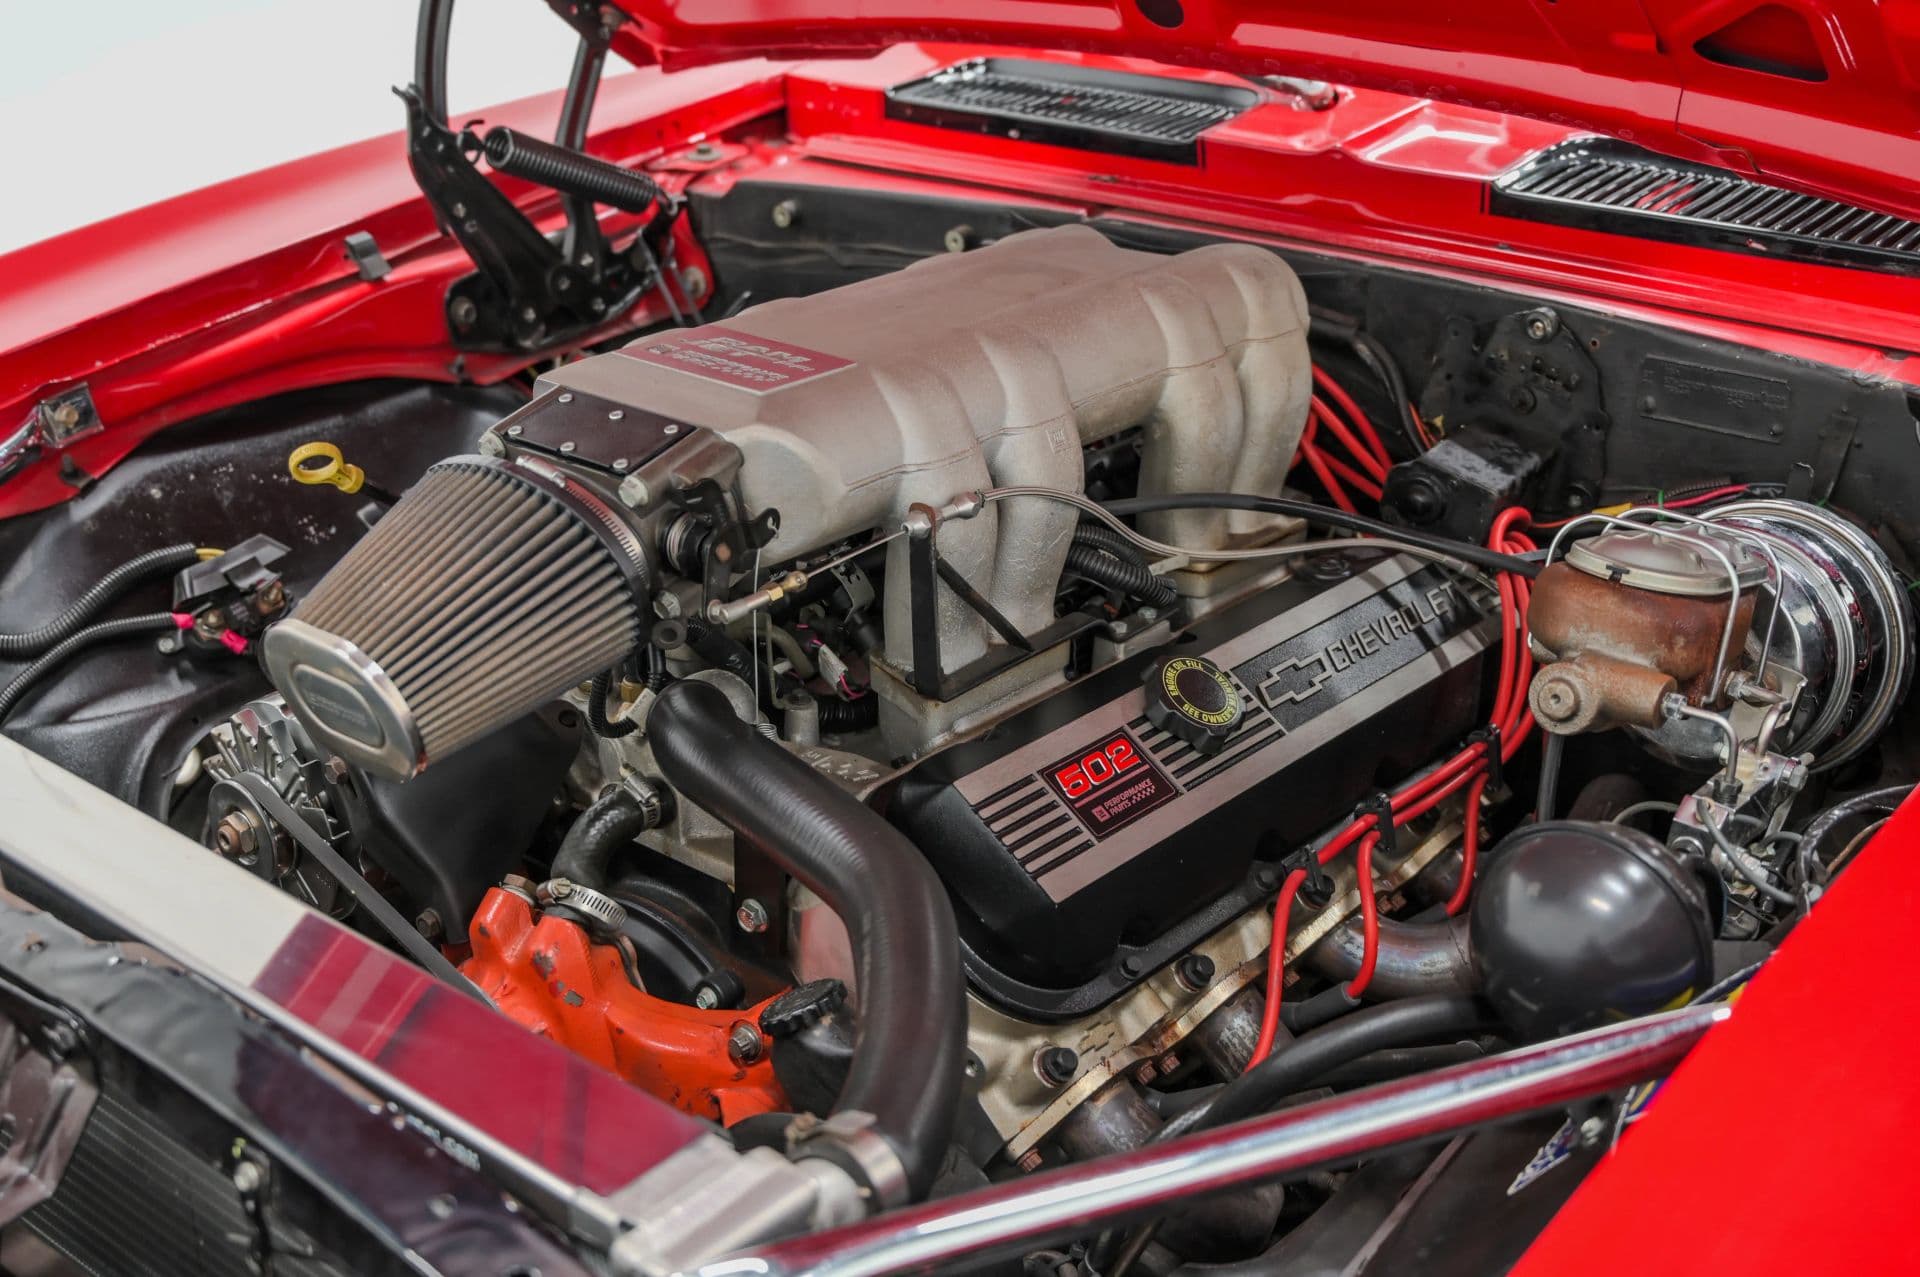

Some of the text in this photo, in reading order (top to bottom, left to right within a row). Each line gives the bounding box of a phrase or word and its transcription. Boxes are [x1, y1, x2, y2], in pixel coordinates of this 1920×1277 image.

[1325, 582, 1457, 673] CHEVROLET
[1166, 660, 1204, 697] ENGINE OIL FILL
[1182, 703, 1200, 719] SEE
[1055, 738, 1142, 799] 502
[1103, 778, 1153, 809] PERFORMANCE
[1109, 800, 1131, 816] PARTS
